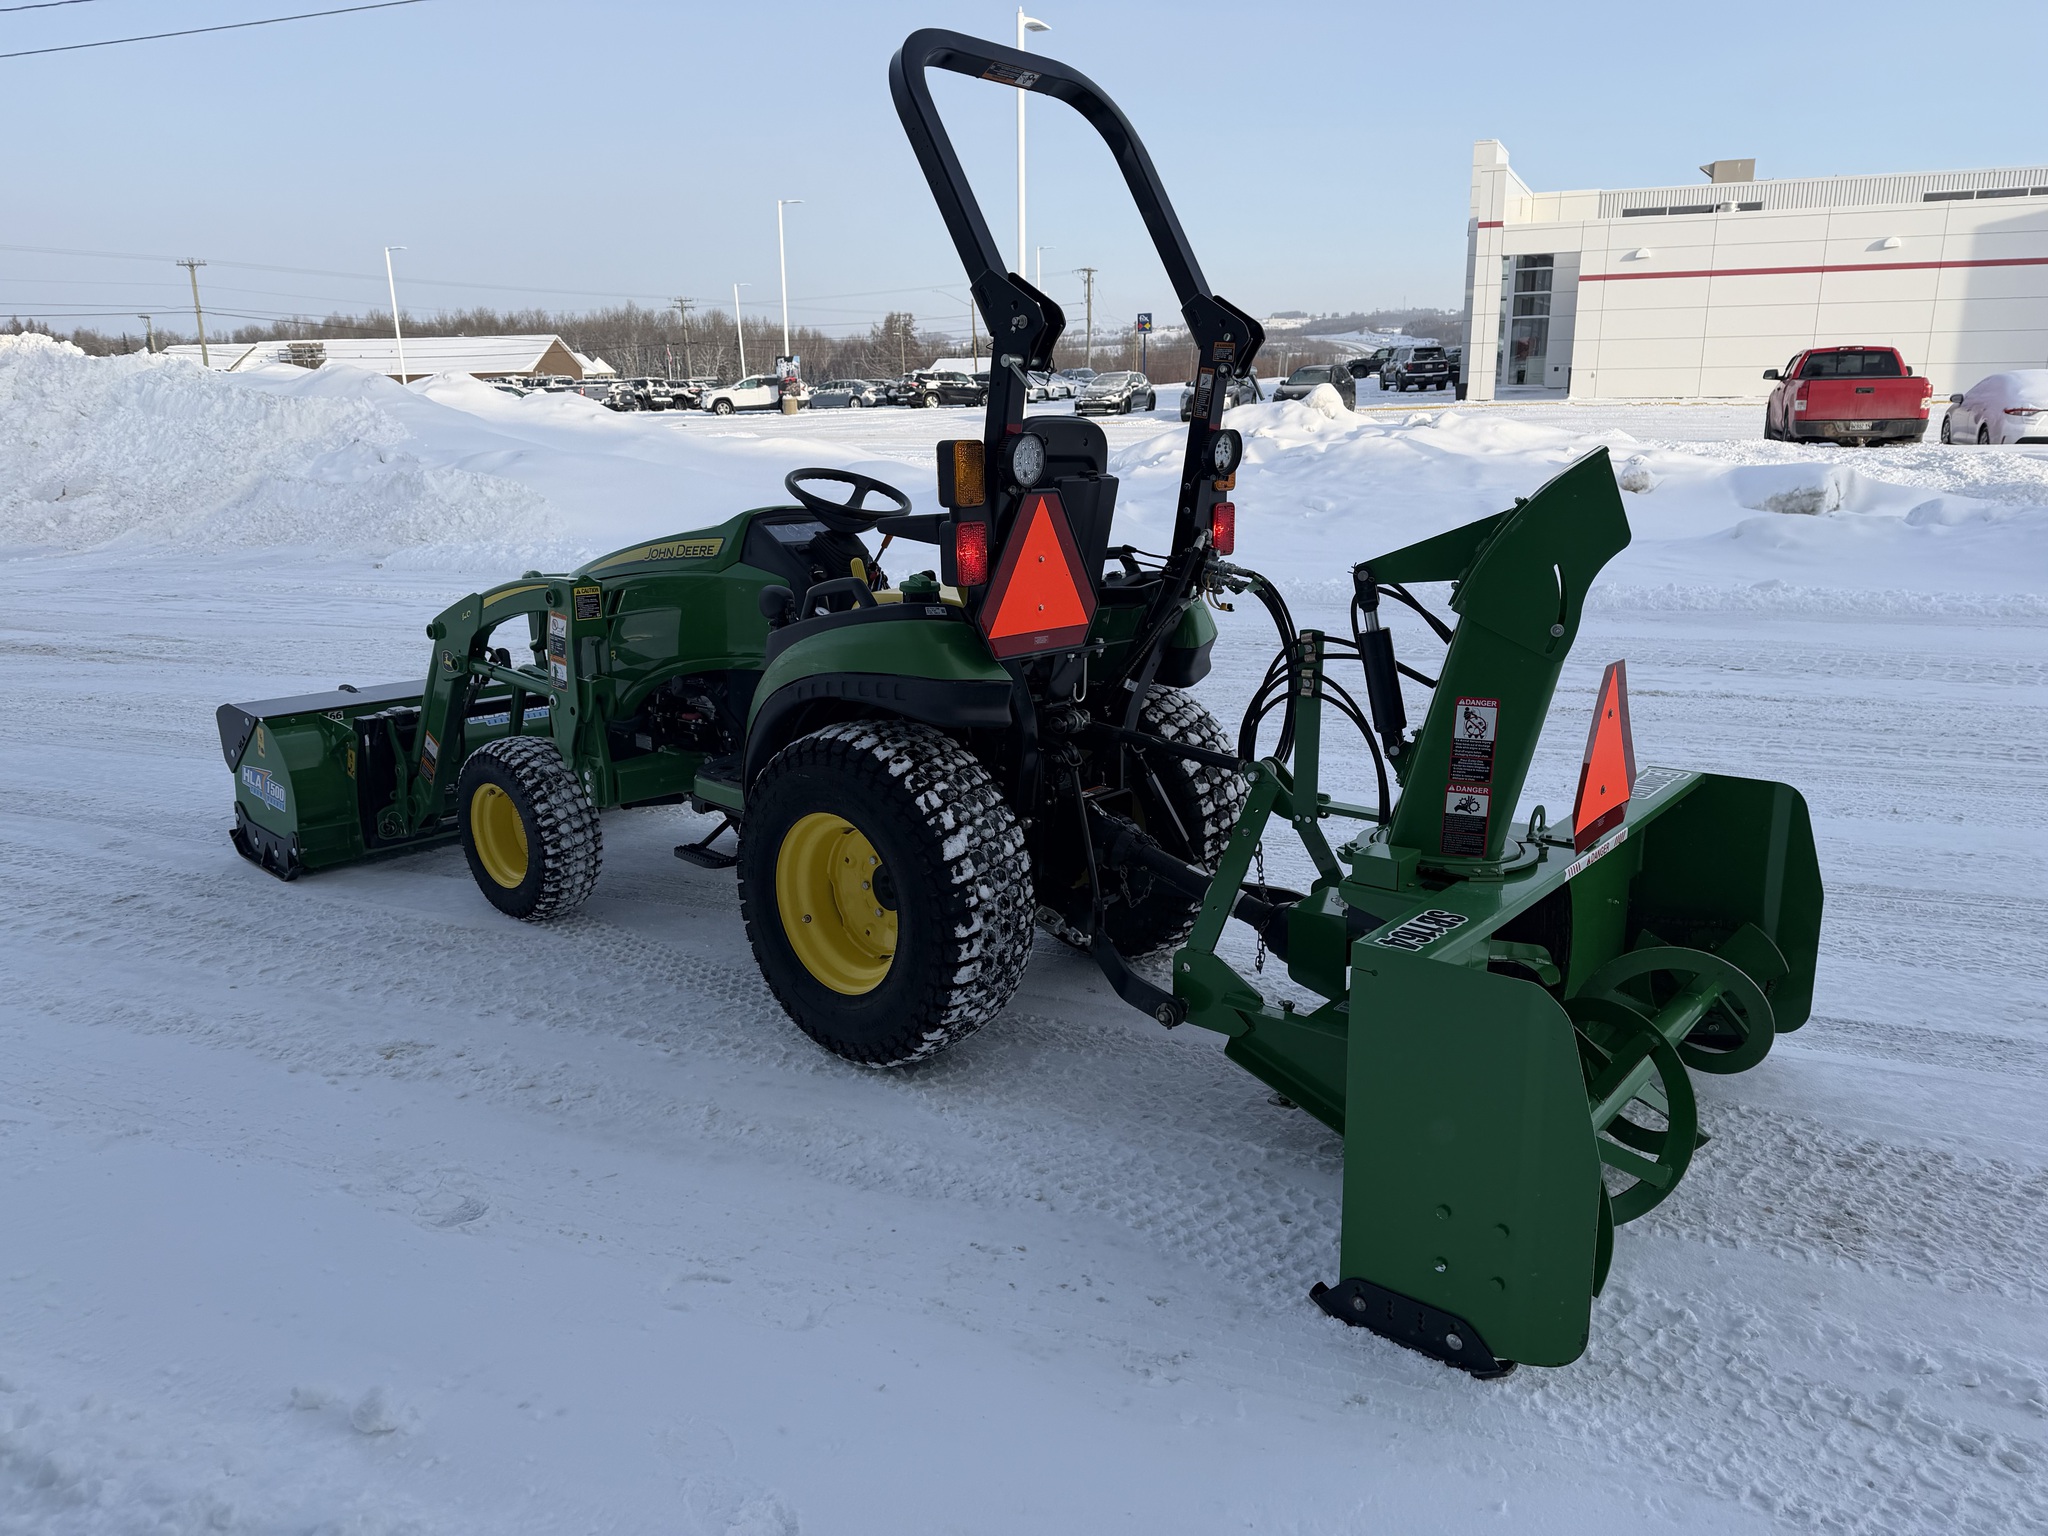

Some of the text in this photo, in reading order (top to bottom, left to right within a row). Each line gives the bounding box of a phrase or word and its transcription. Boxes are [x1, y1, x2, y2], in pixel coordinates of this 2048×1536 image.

[644, 544, 715, 560] JOHN DEERE
[1465, 699, 1497, 707] DANGER
[243, 767, 262, 790] HLA
[266, 781, 284, 802] 1500
[1455, 785, 1489, 794] DANGER
[1590, 842, 1610, 863] DANGER
[1375, 910, 1468, 951] SB1164
